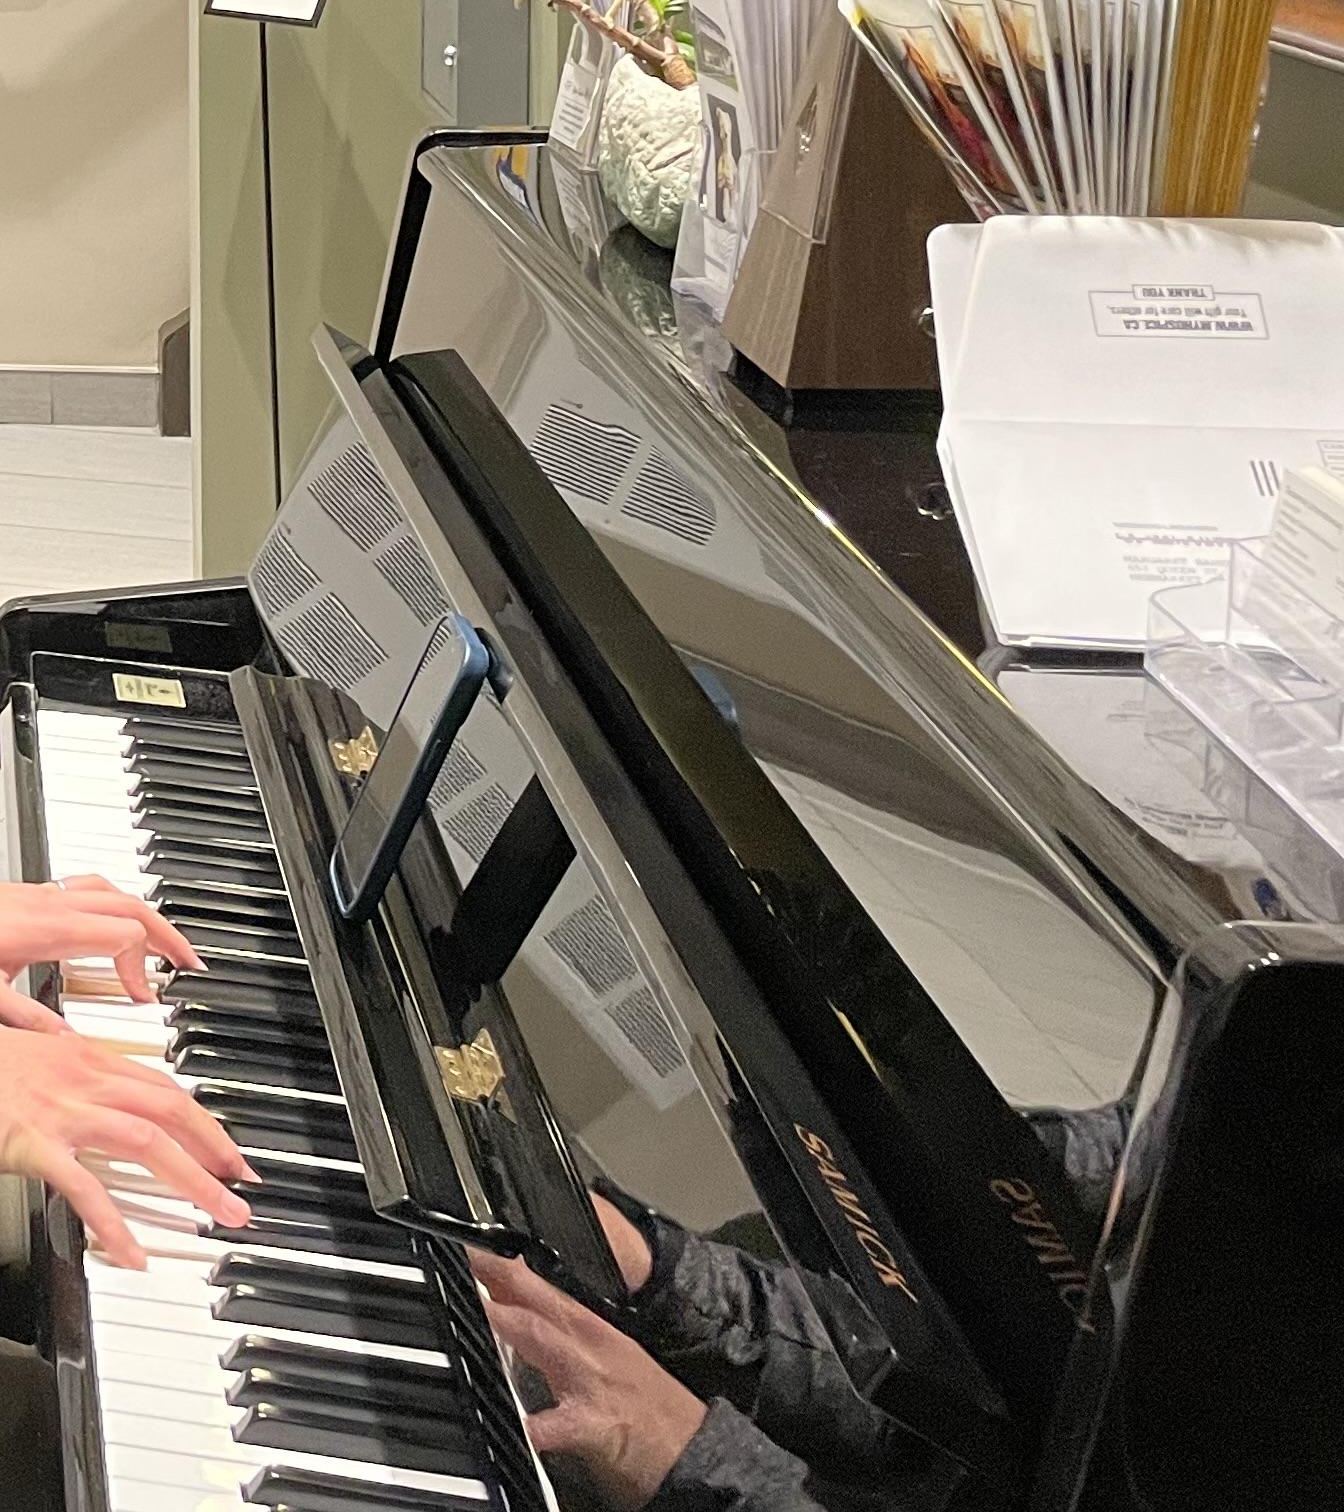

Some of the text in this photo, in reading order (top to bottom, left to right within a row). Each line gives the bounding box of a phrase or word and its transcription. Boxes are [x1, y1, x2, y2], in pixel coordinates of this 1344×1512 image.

[1142, 287, 1208, 298] THANK YOU
[1145, 306, 1159, 316] for
[1161, 307, 1183, 317] care
[1184, 307, 1204, 317] will
[1224, 308, 1248, 318] Your
[793, 1122, 918, 1303] SAMICK
